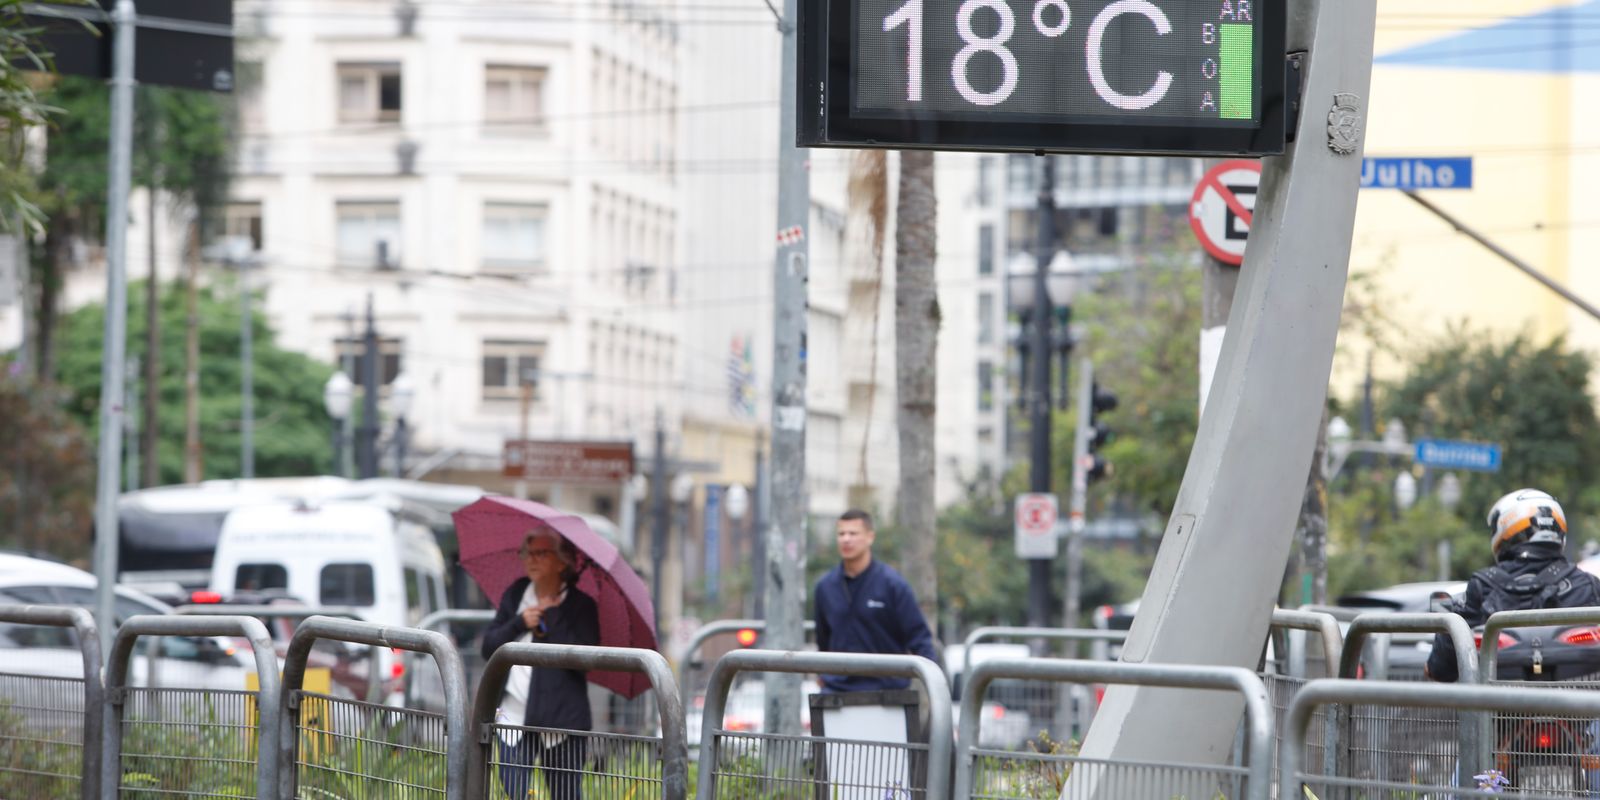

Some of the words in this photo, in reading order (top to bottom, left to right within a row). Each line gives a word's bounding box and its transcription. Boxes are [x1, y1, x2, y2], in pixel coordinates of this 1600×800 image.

[1219, 0, 1252, 20] AR
[882, 0, 1174, 110] 18°C
[1360, 158, 1456, 187] Julho
